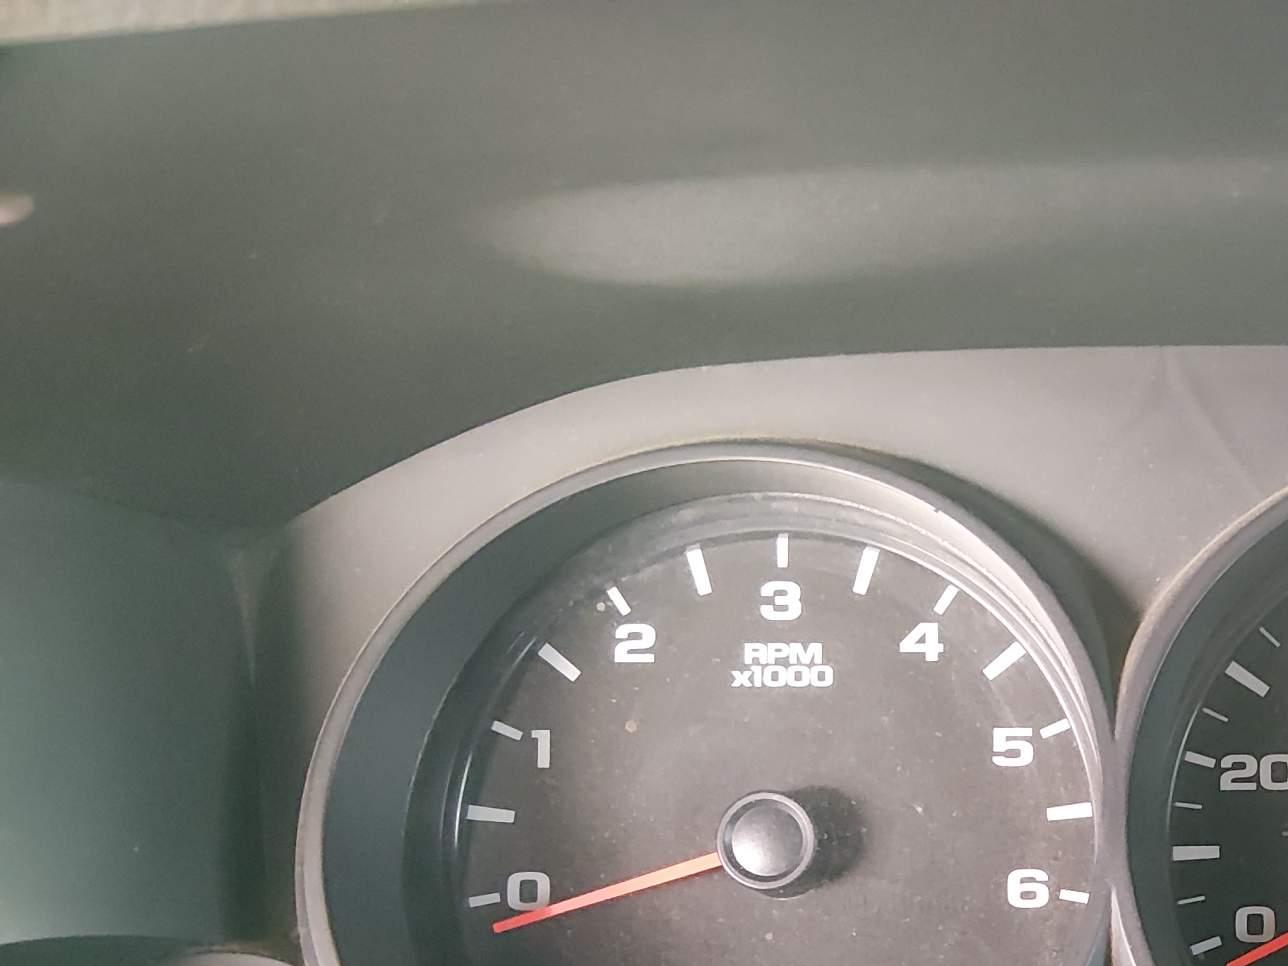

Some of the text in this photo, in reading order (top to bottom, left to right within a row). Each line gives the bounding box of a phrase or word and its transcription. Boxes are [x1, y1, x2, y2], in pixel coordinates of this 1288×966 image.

[759, 581, 802, 621] 3
[614, 624, 656, 663] 2
[744, 642, 823, 665] RPM
[899, 623, 944, 662] 4
[731, 665, 834, 688] x1000
[531, 730, 551, 768] 1
[992, 728, 1034, 767] 5
[507, 872, 551, 911] 0
[1006, 869, 1050, 908] 6
[1234, 907, 1275, 943] 0
